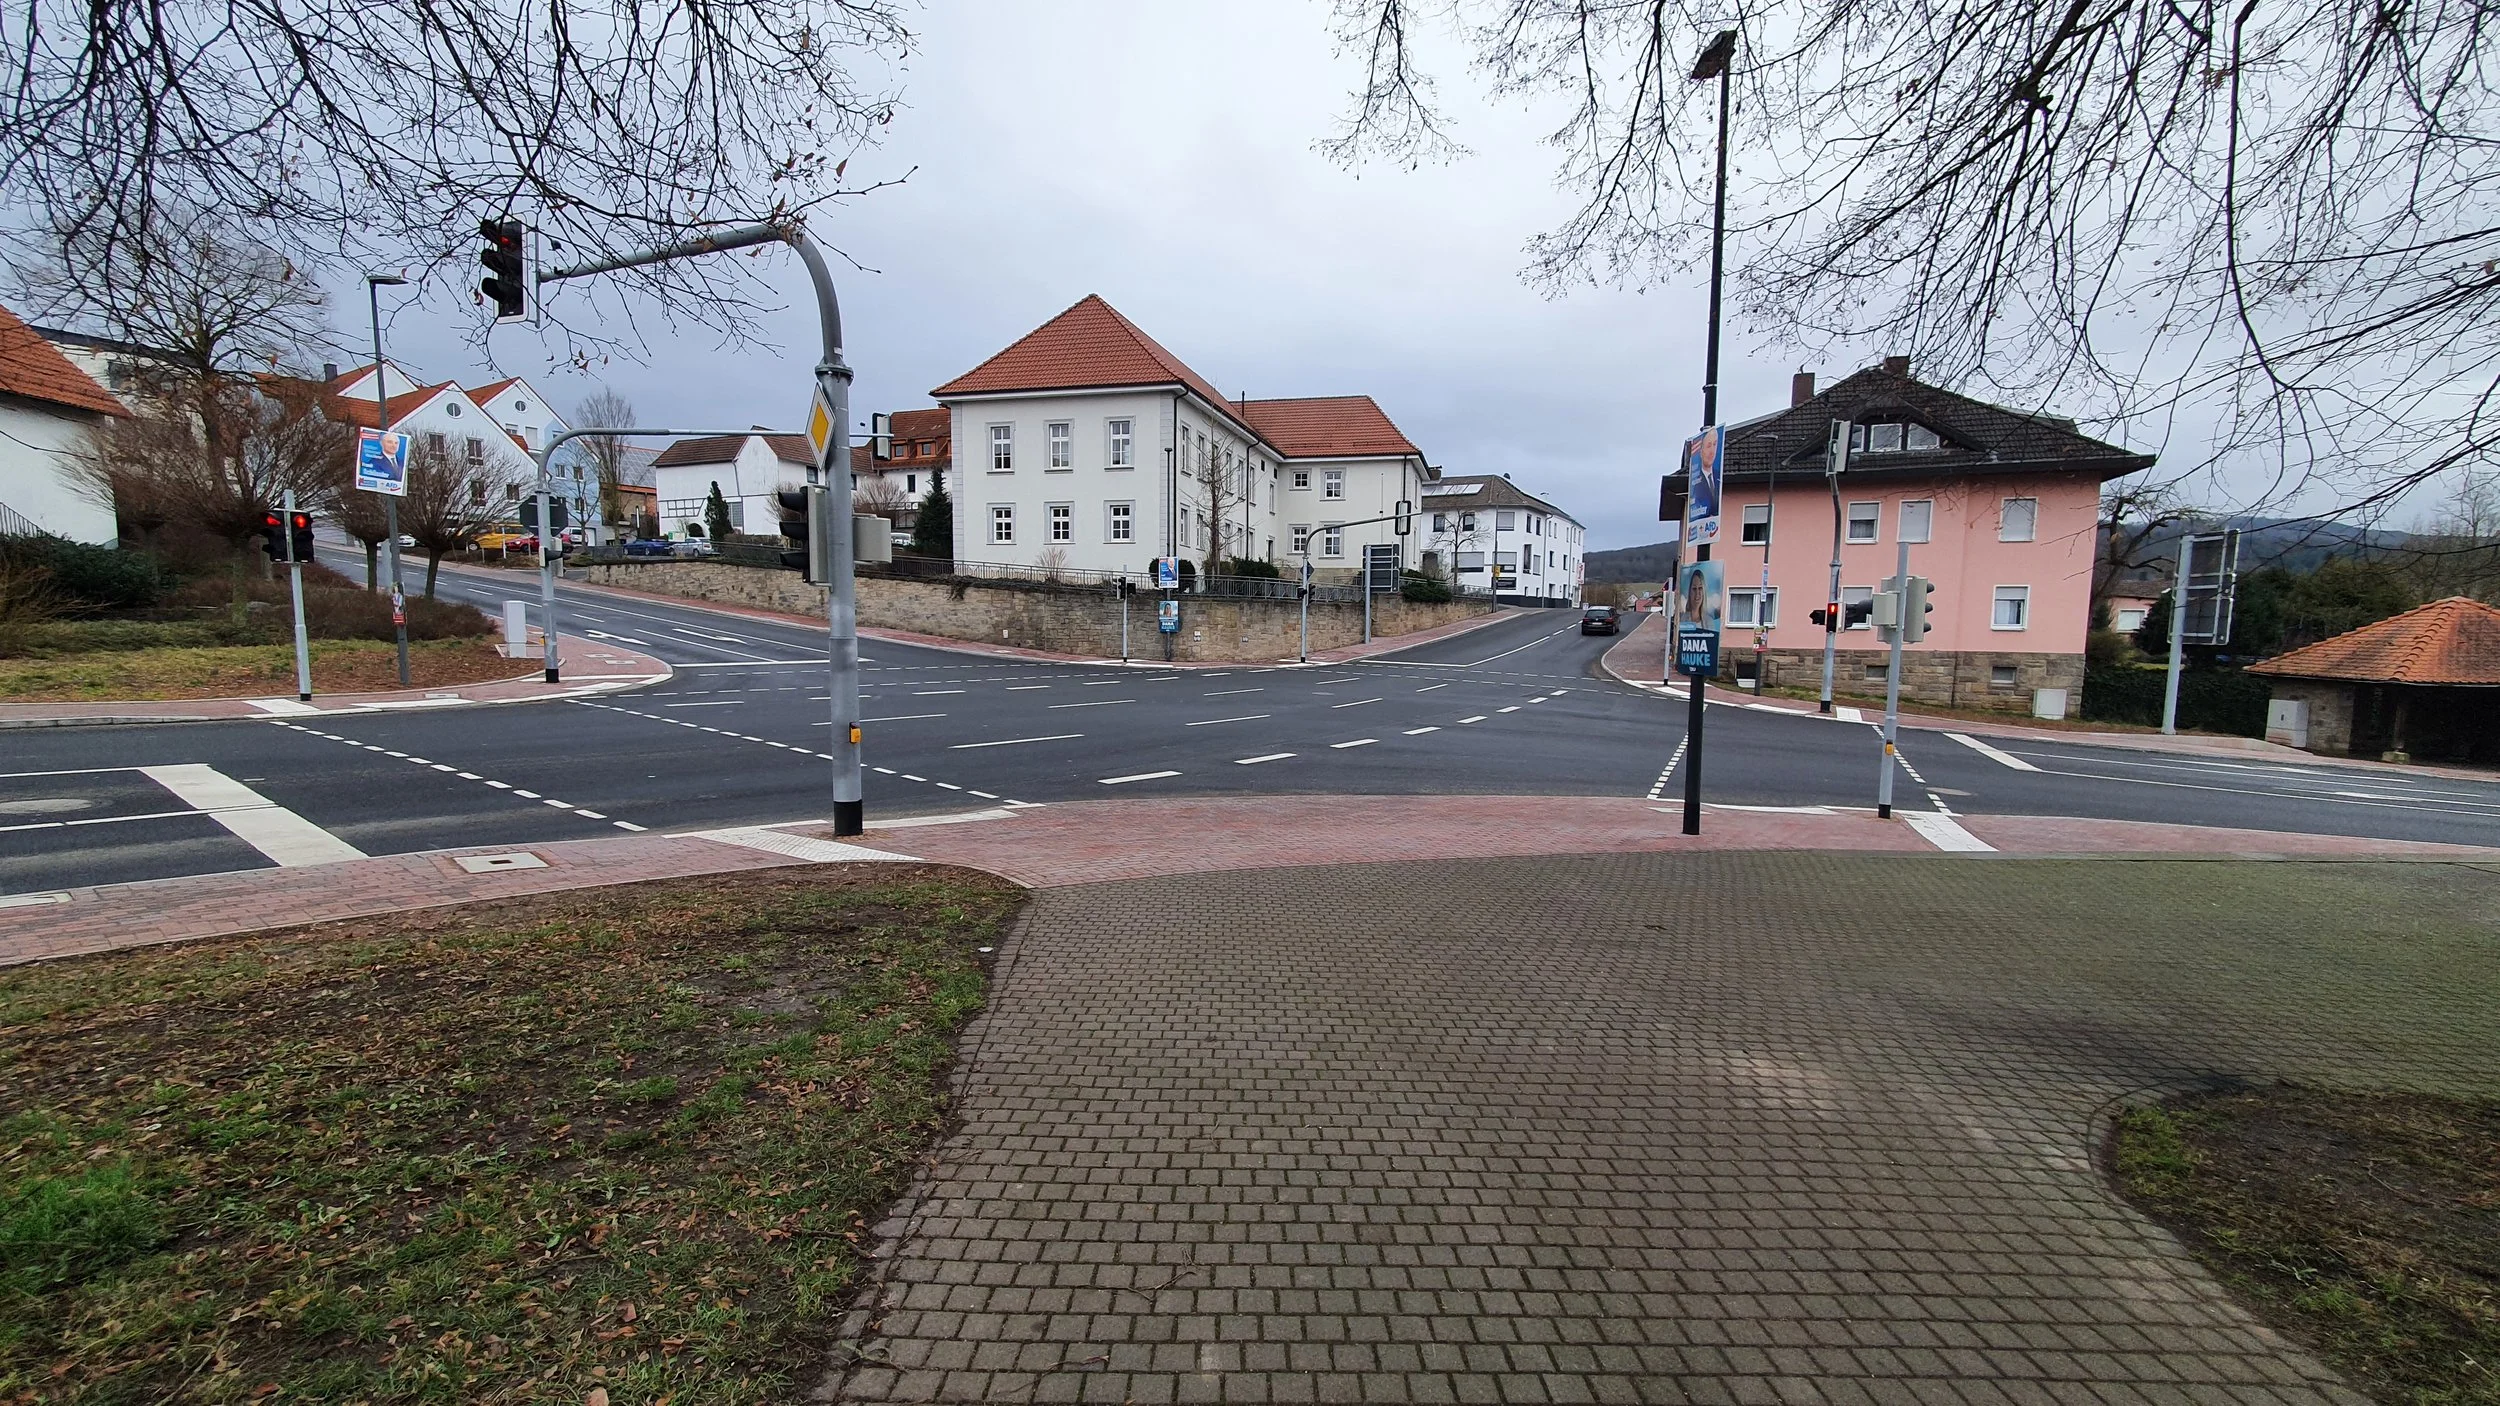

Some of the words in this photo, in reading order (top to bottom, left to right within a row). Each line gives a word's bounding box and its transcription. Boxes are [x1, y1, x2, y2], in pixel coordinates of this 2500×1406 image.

[1704, 521, 1717, 533] AfD
[1682, 639, 1708, 653] DANA
[1681, 653, 1711, 667] HAUKE
